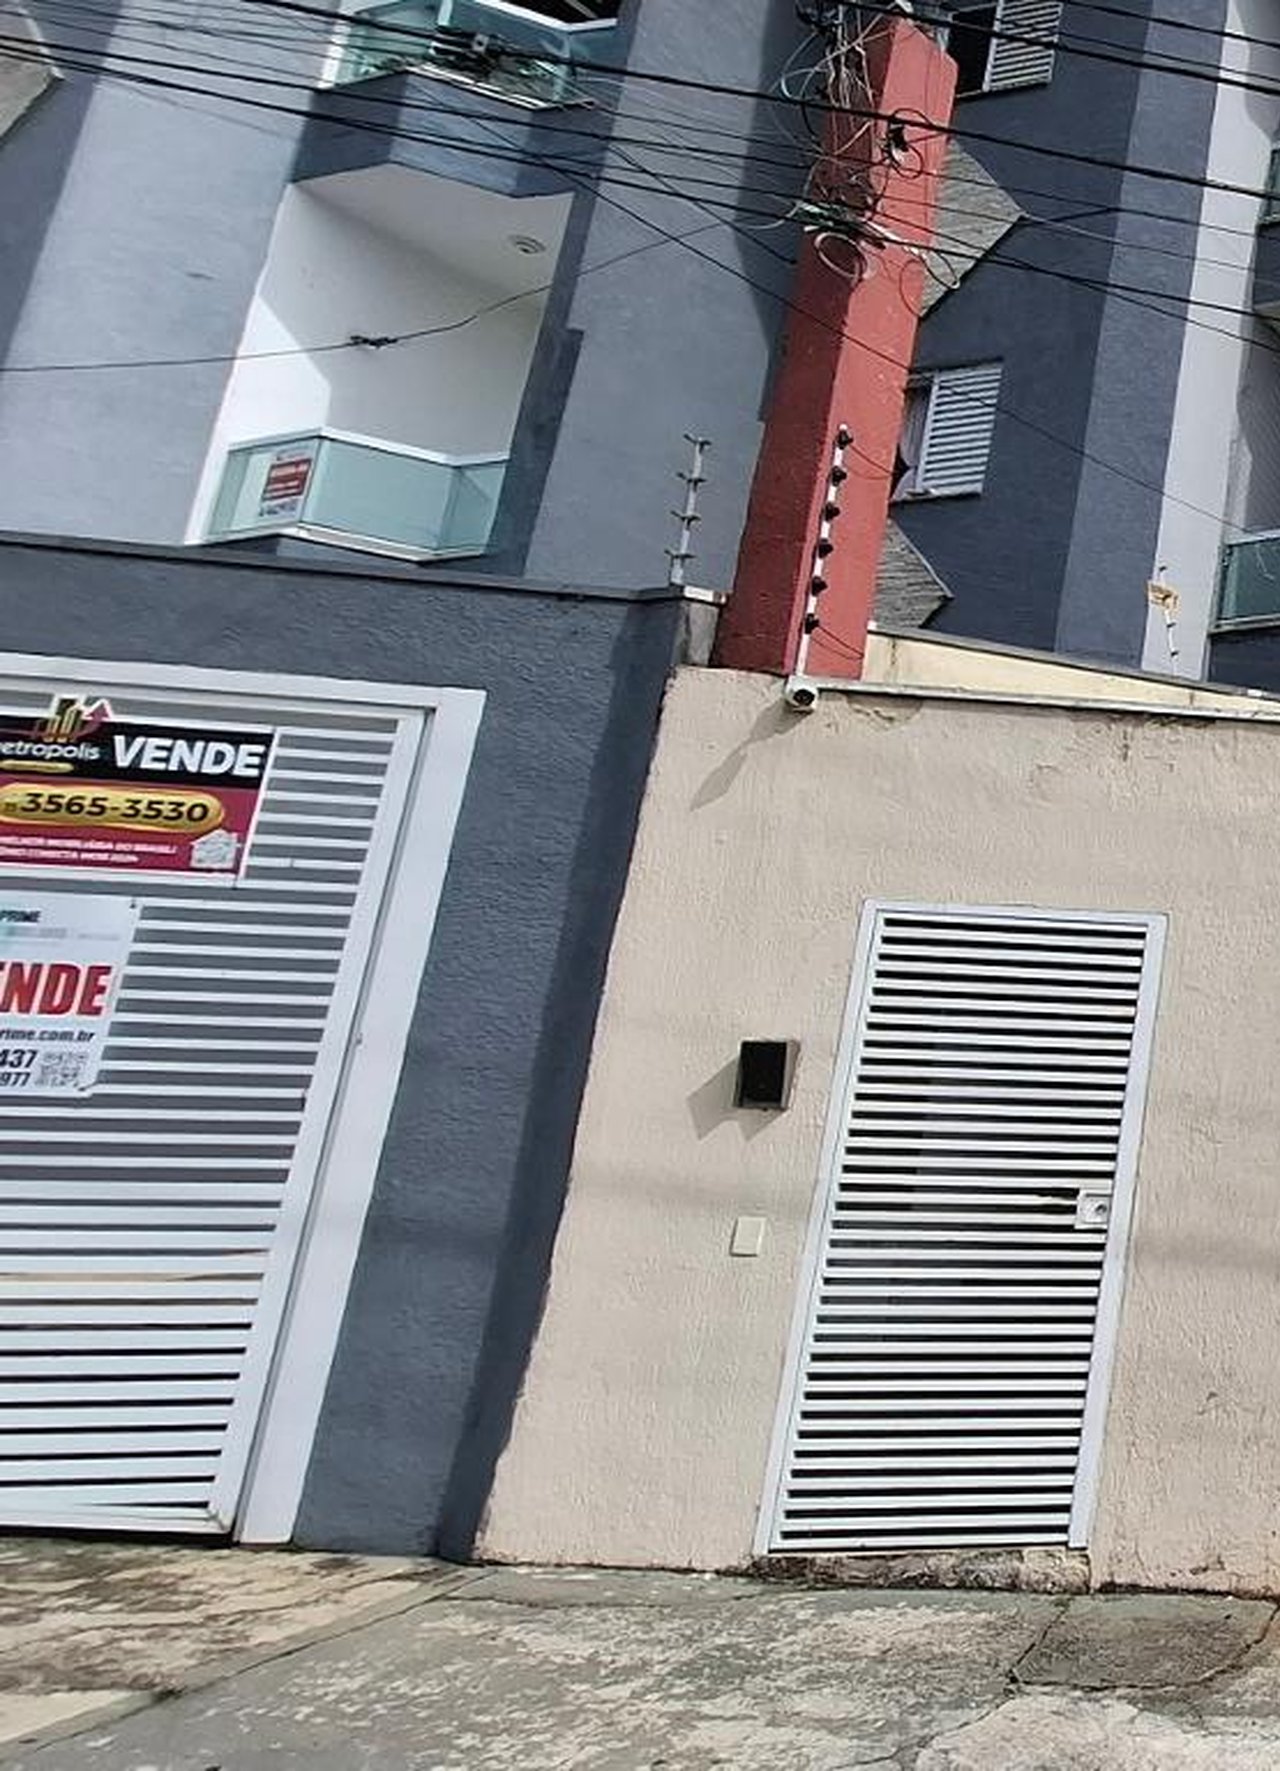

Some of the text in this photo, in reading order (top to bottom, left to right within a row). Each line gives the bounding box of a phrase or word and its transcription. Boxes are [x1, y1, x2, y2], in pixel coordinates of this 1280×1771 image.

[0, 741, 100, 759] etropolis
[114, 735, 265, 777] VENDE
[21, 792, 208, 822] 3565-3530
